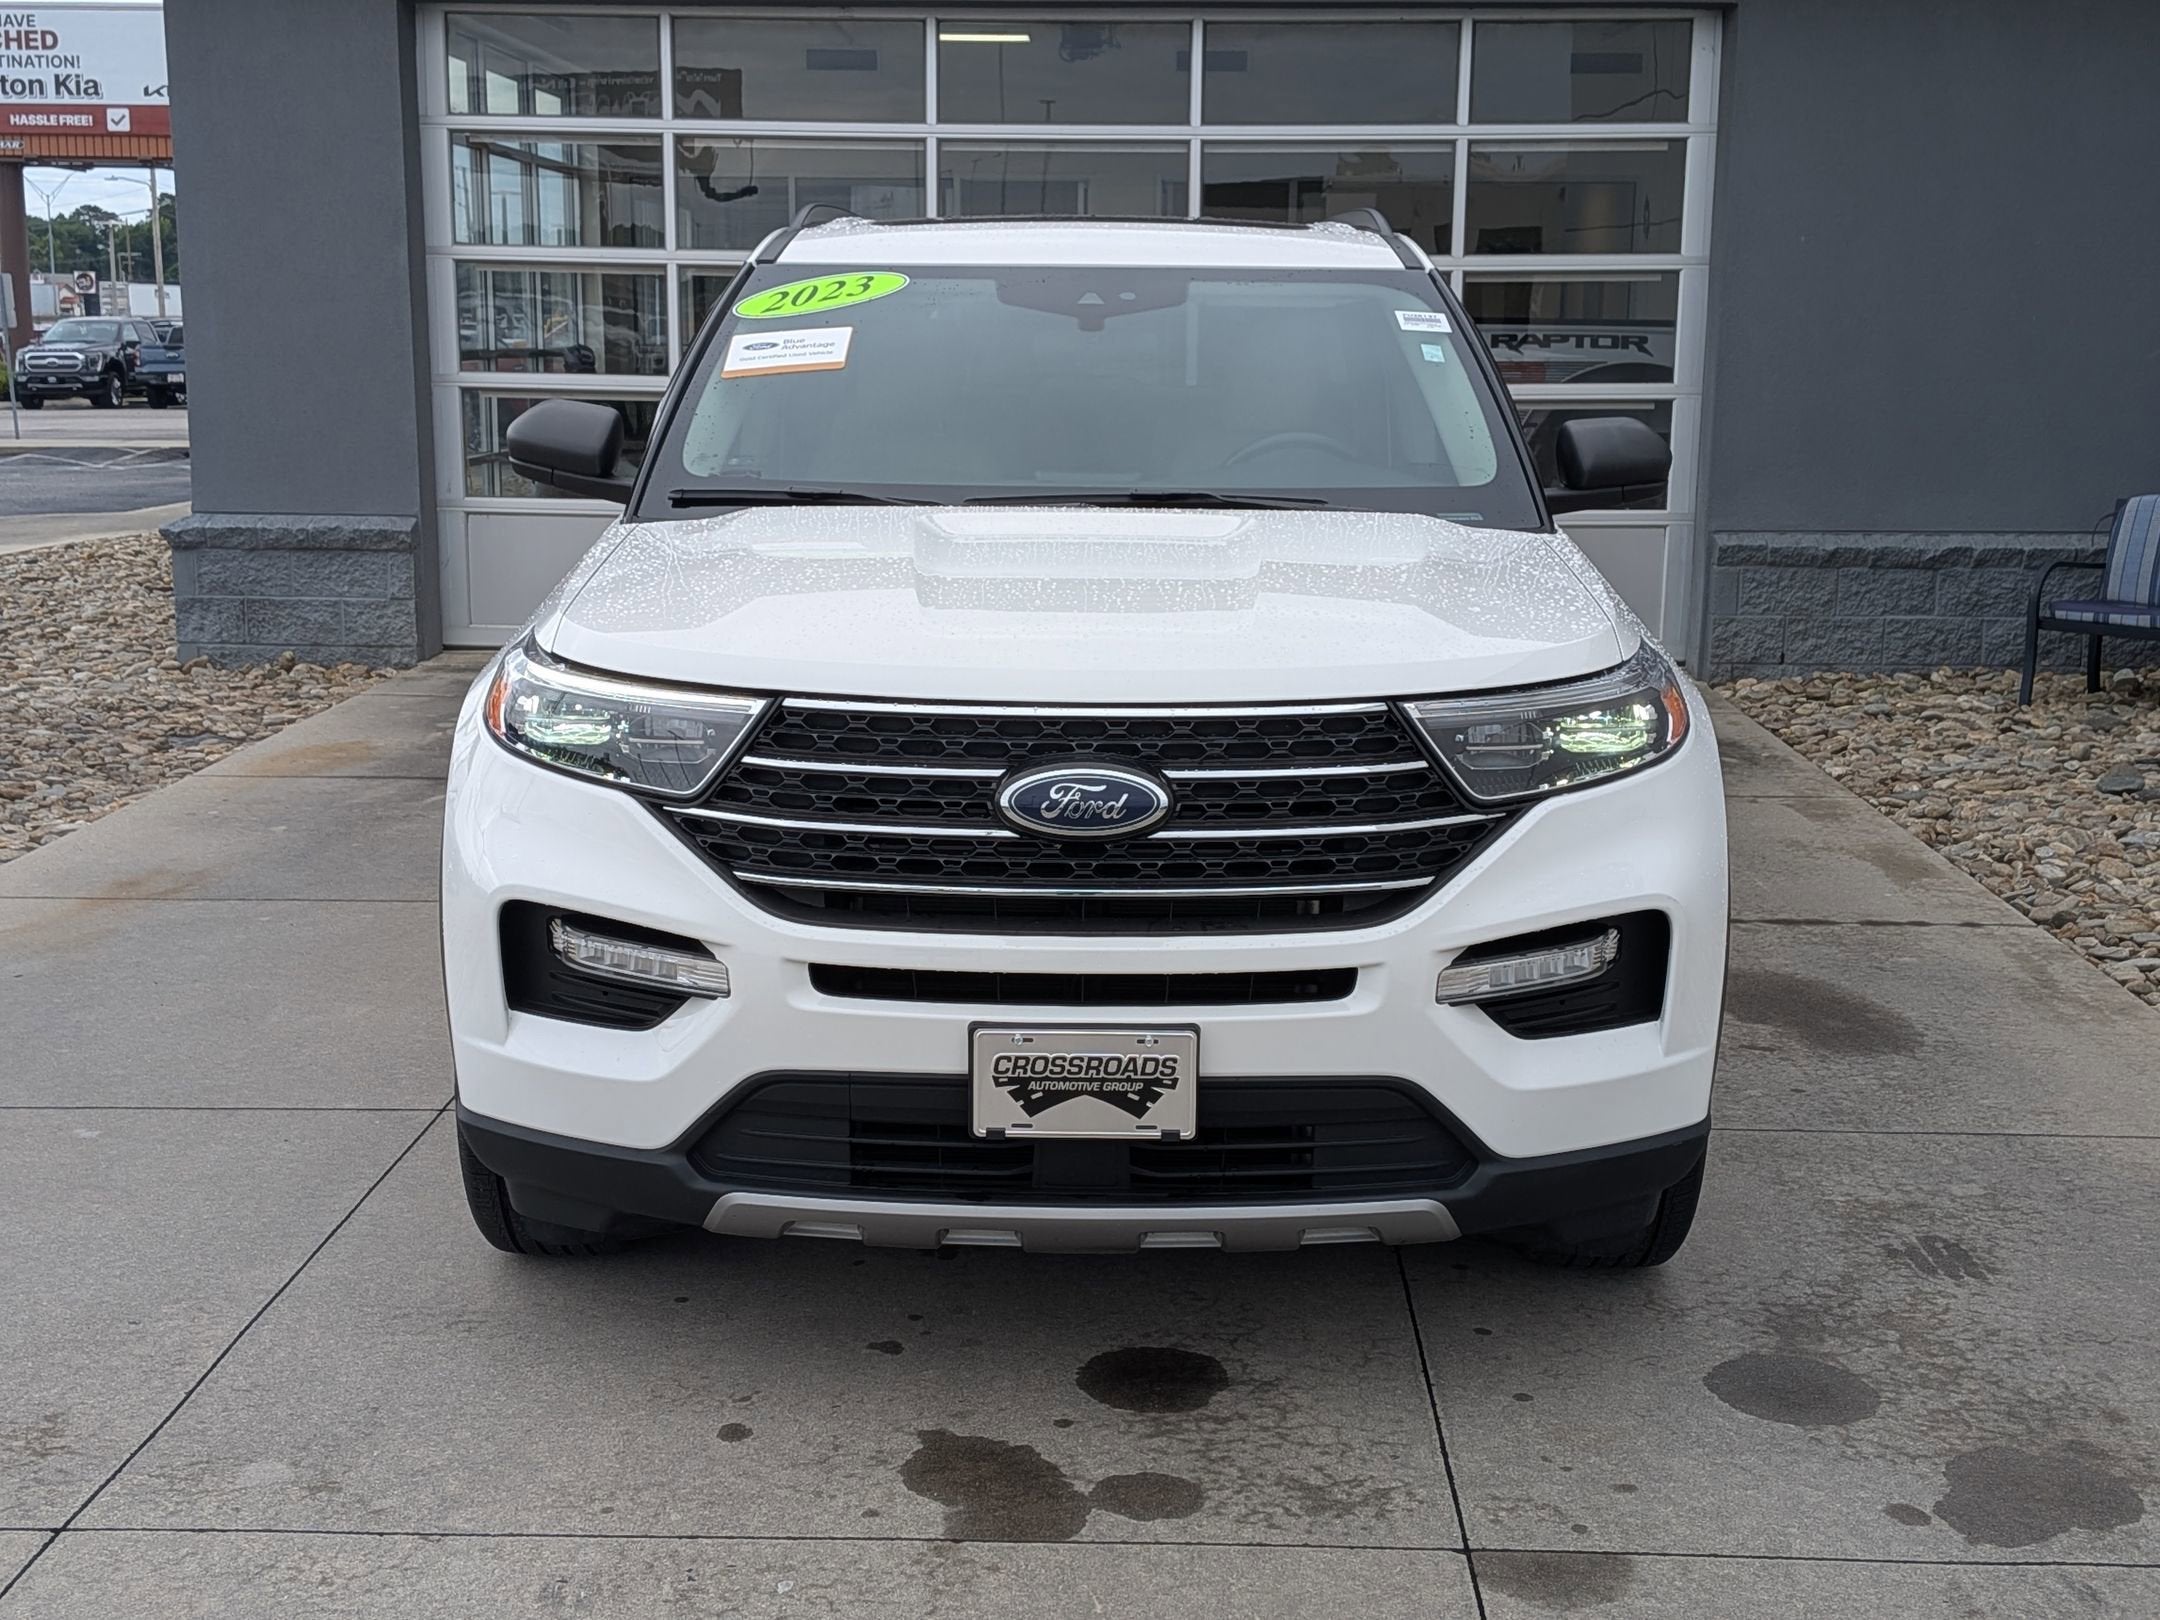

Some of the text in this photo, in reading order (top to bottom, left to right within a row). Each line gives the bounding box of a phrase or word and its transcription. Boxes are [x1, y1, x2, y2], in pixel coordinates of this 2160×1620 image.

[0, 13, 36, 28] AVE
[0, 29, 59, 50] HED
[54, 73, 101, 97] Kia
[9, 113, 94, 127] HASSLE FREE!
[760, 275, 875, 314] 2023
[780, 341, 836, 350] Advantage
[1490, 333, 1654, 358] RAPTOR
[1040, 783, 1128, 819] Ford
[993, 1055, 1178, 1078] CROSSROADS
[1027, 1080, 1143, 1092] AUTOMOTIVE GROUP
